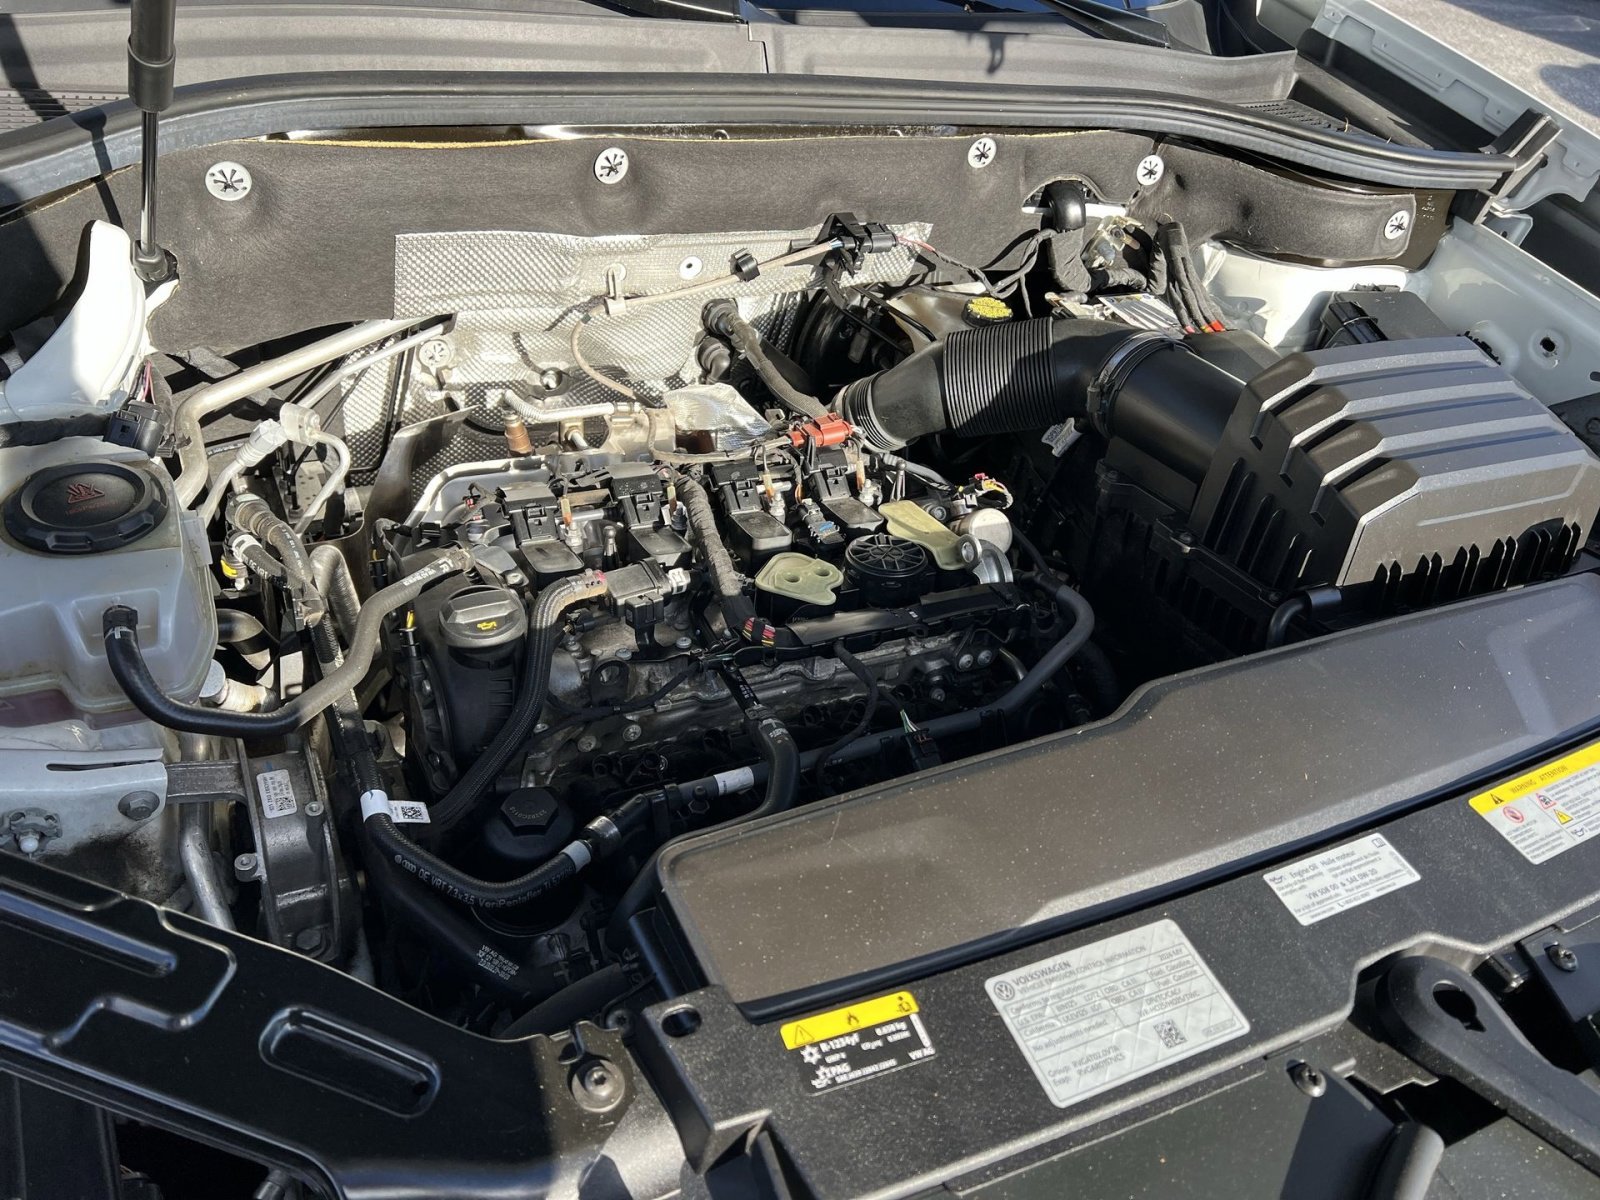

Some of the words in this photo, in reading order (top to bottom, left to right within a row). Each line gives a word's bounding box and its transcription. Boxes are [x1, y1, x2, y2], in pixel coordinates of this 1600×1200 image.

[1289, 867, 1310, 878] Engine
[429, 876, 446, 890] VRT
[1305, 891, 1318, 899] VW
[1165, 958, 1191, 971] Gasoline
[1012, 960, 1071, 986] VOLKSWAGEN
[1172, 968, 1198, 981] Gasoline
[820, 1033, 860, 1053] R-1234yf
[909, 1049, 922, 1059] VW
